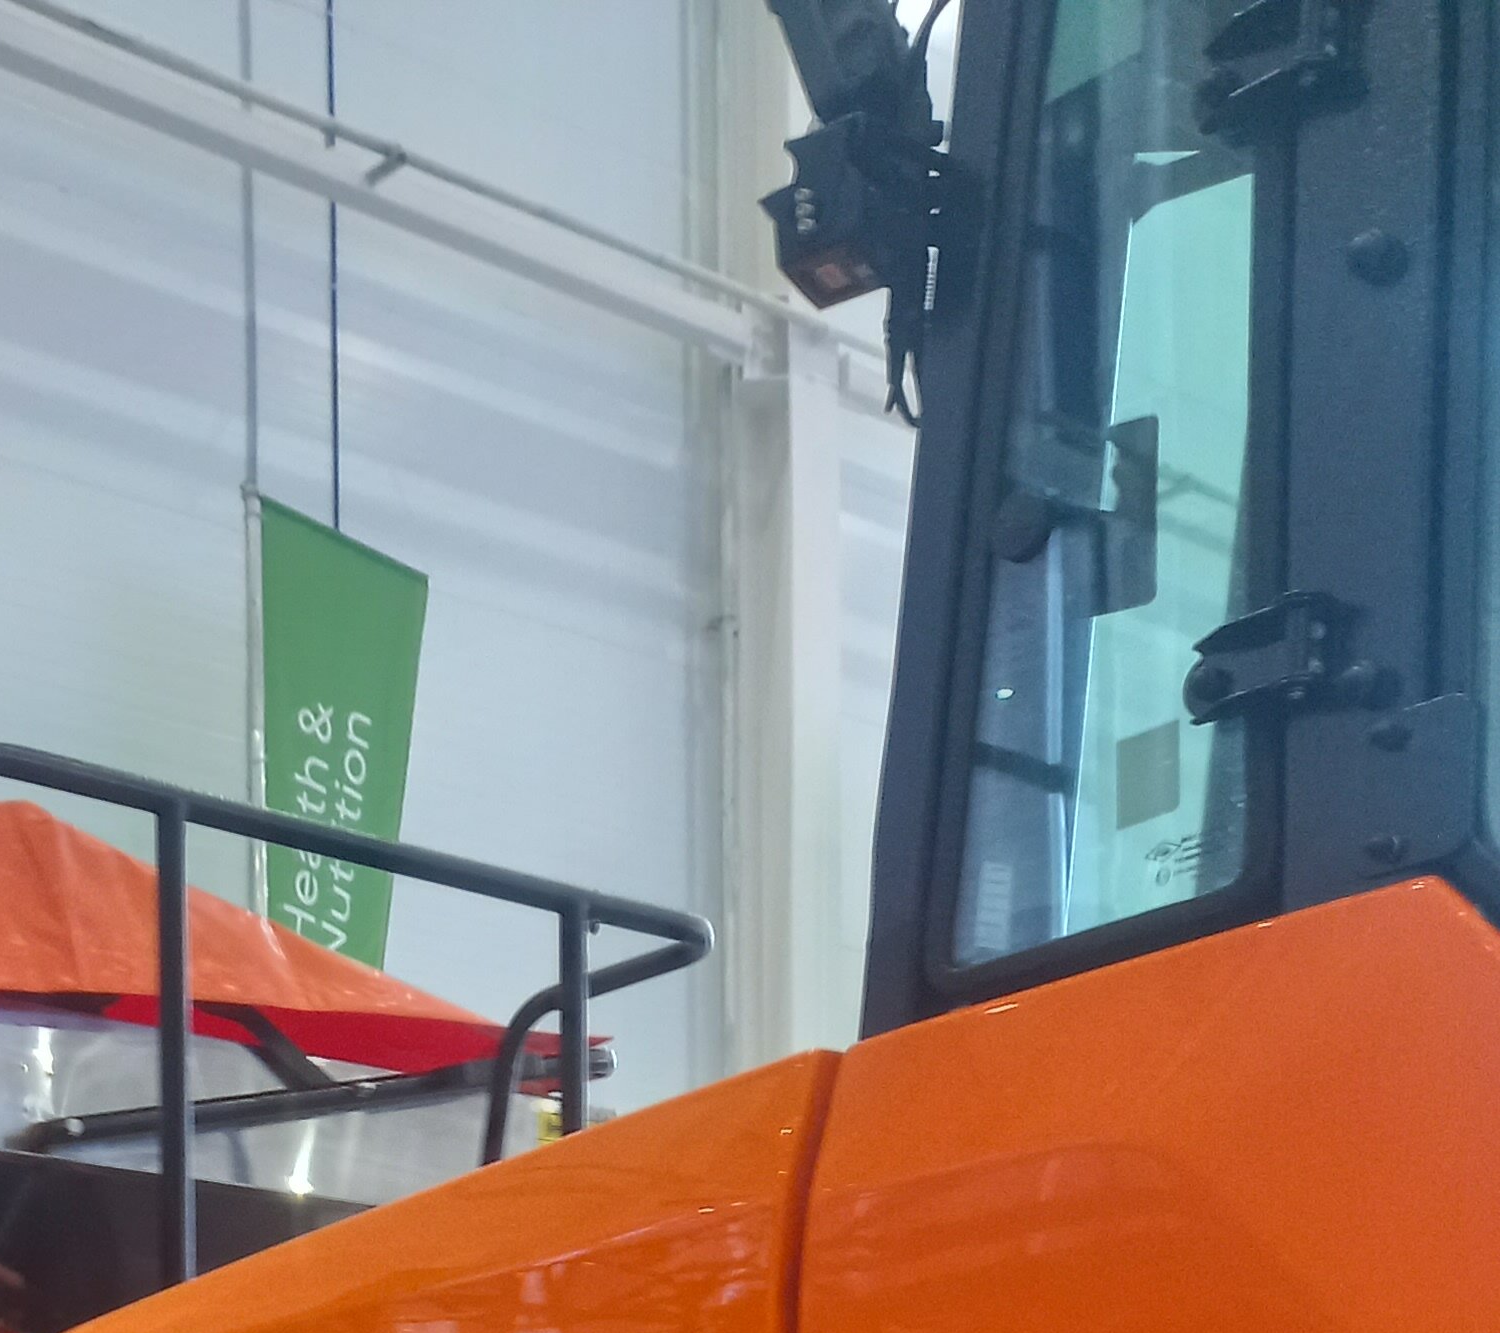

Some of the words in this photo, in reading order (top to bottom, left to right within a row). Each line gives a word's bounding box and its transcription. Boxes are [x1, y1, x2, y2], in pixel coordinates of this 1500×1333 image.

[298, 702, 334, 744] &
[284, 755, 329, 935] Heath
[321, 710, 372, 951] Nuttion
